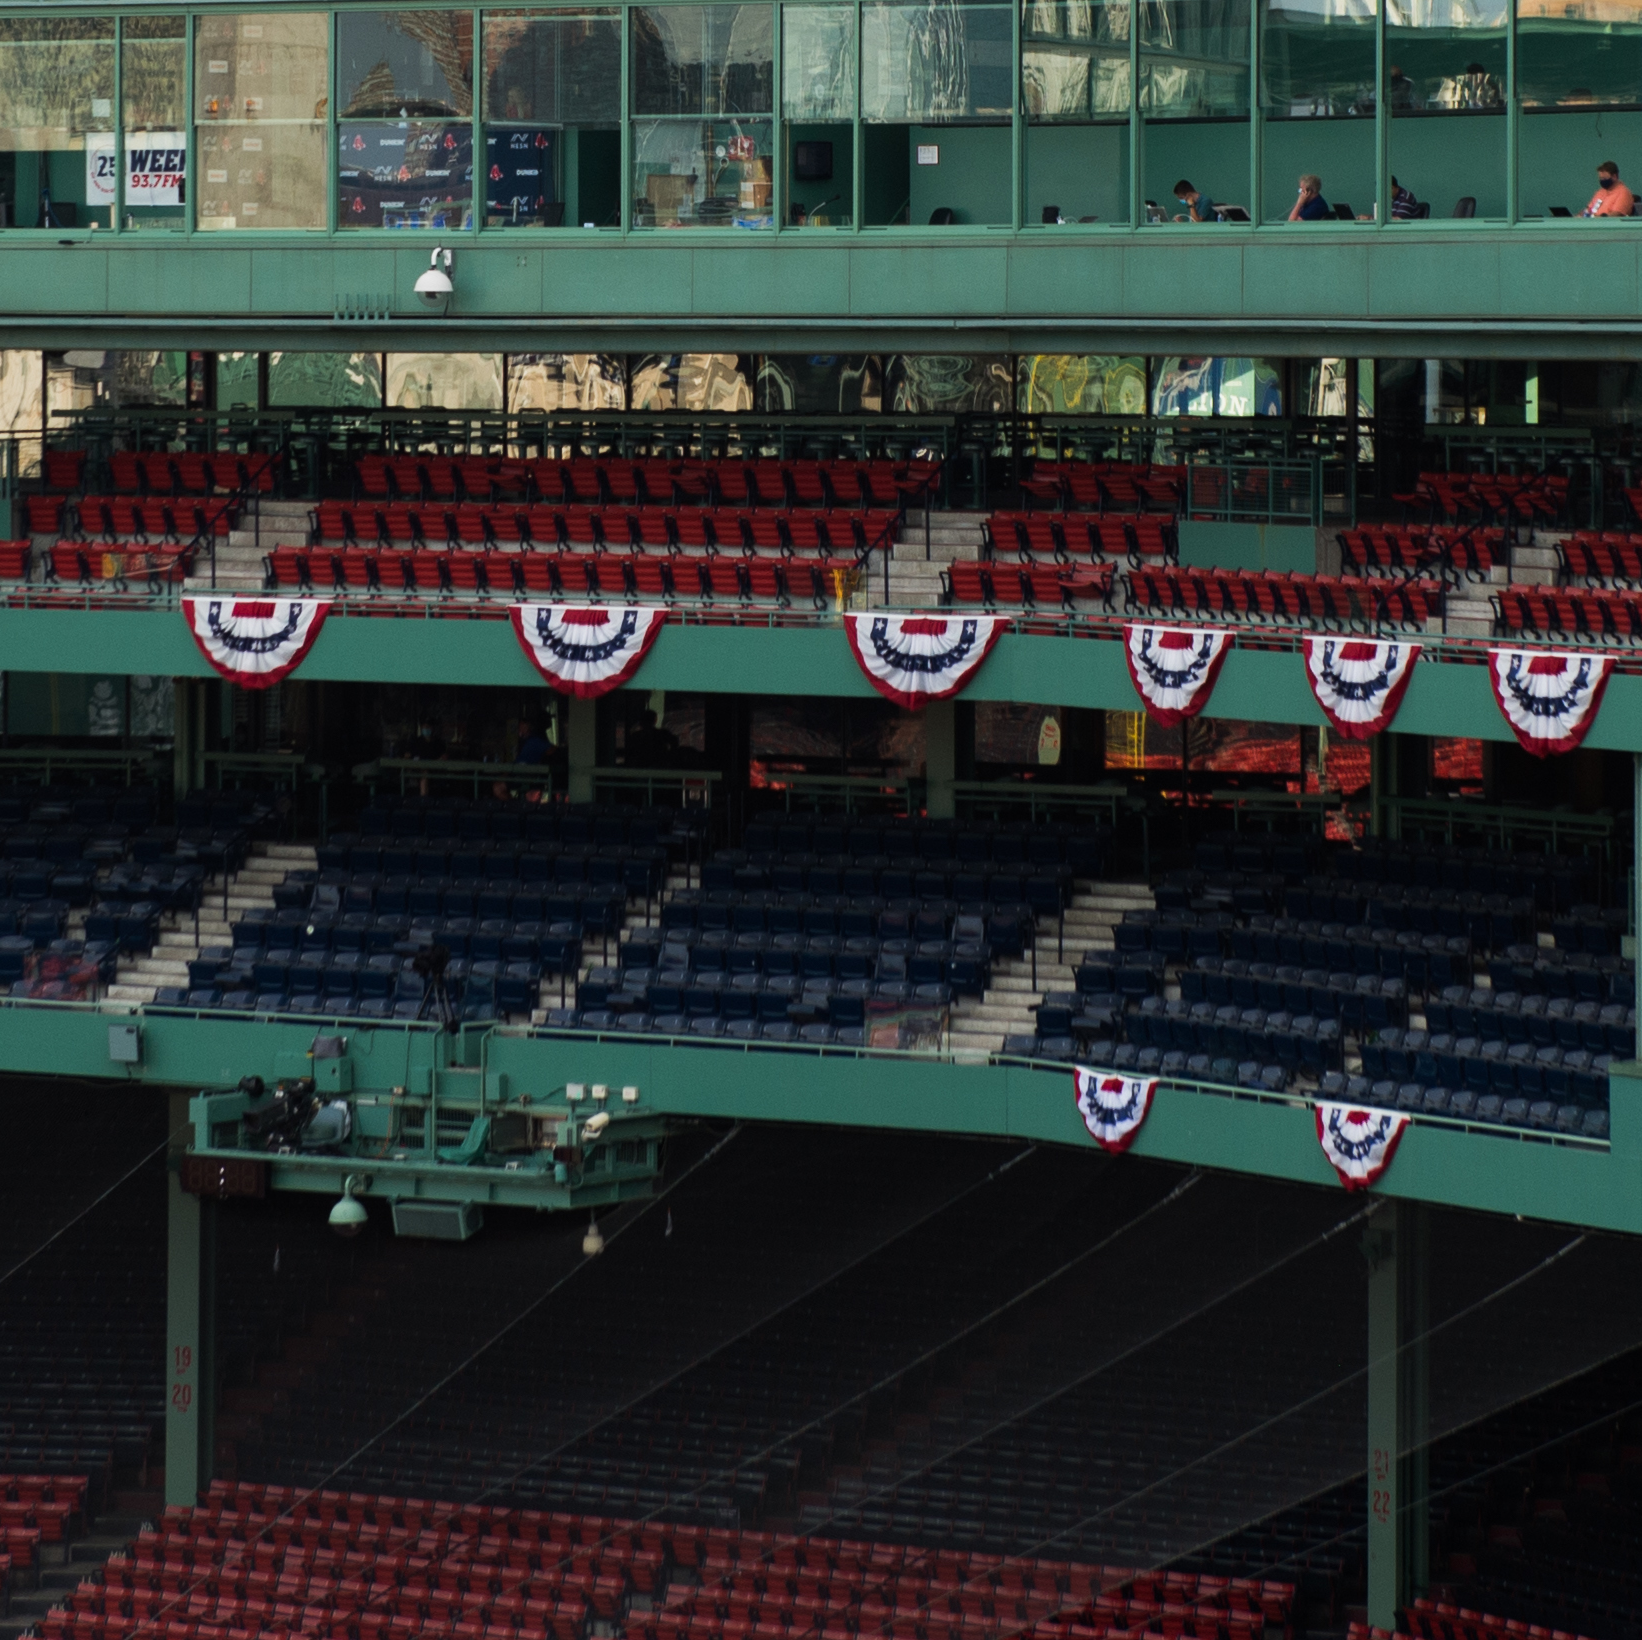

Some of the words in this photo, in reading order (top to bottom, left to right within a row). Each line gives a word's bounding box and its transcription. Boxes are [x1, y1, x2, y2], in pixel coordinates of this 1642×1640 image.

[174, 1345, 191, 1367] 19
[172, 1383, 191, 1405] 20
[1373, 1490, 1390, 1515] 22
